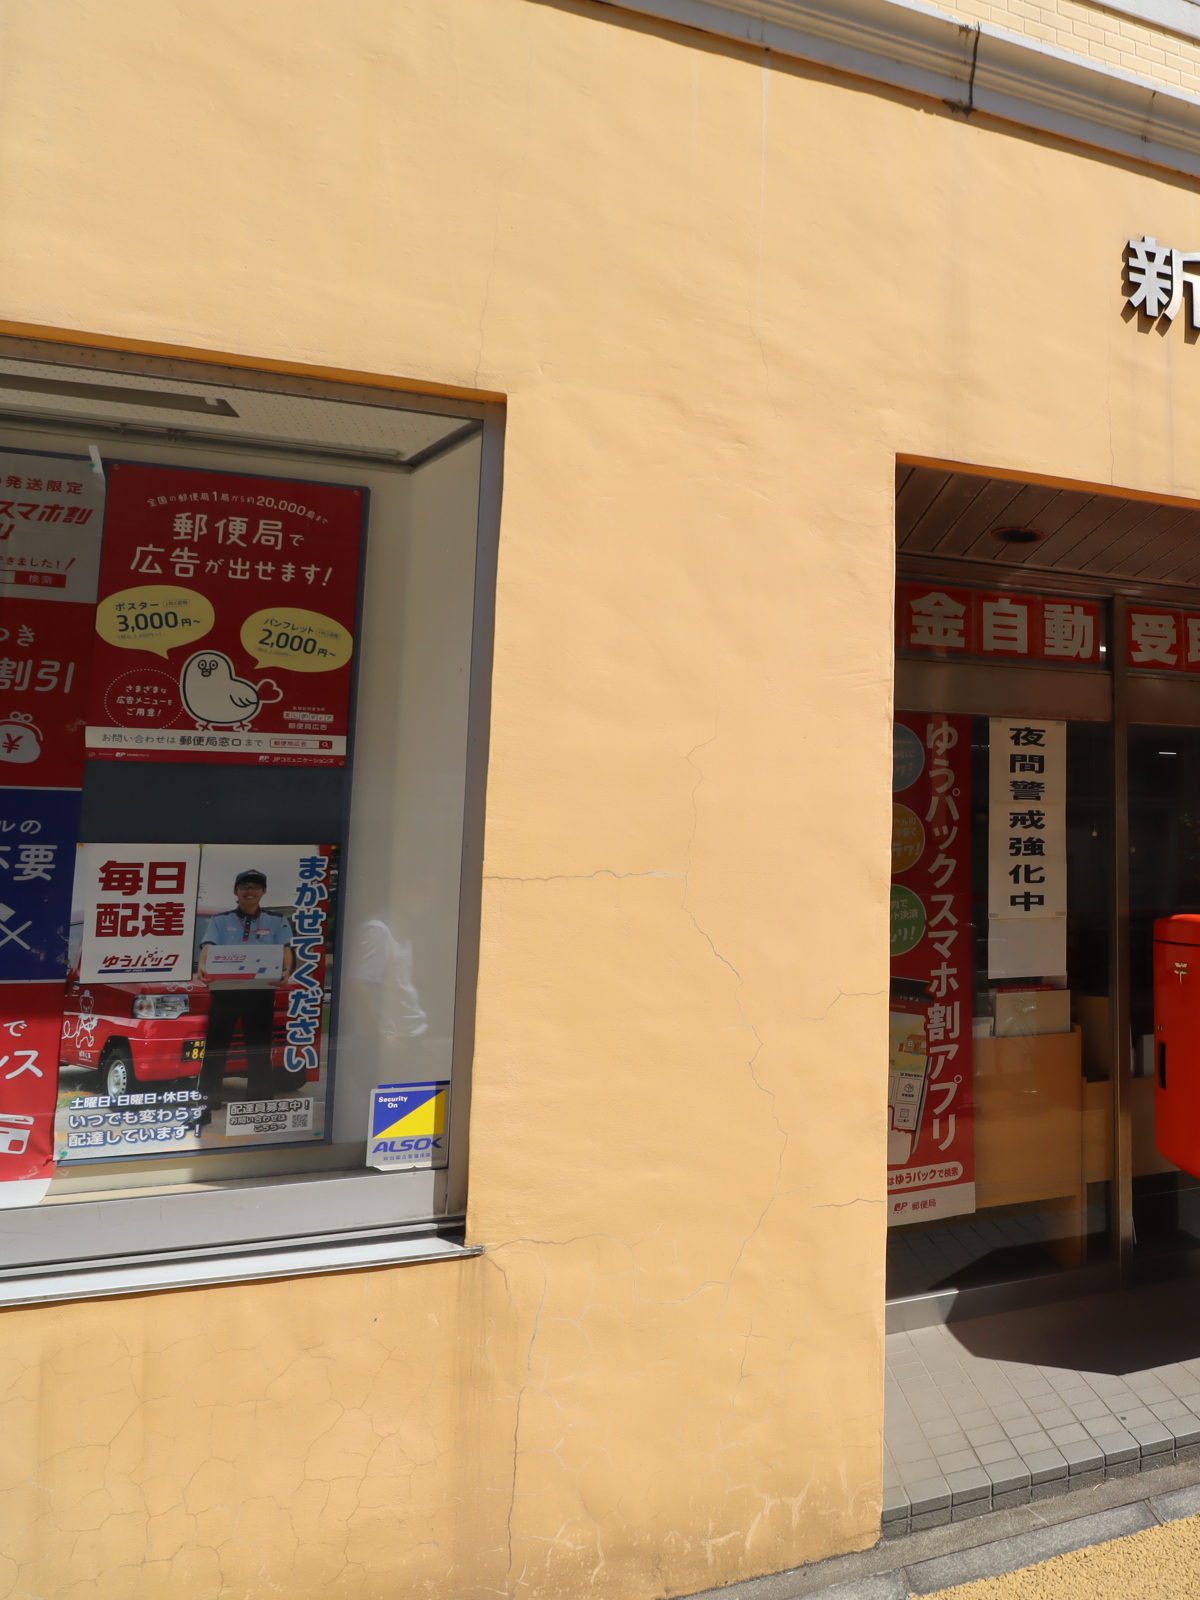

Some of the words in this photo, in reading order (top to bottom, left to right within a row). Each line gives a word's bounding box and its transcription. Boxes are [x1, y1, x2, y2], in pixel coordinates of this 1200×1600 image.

[0, 475, 84, 496] 発送限定
[173, 511, 305, 551] 郵便局で
[0, 556, 61, 570] きました!
[130, 543, 333, 587] 広告が出せます!
[28, 573, 54, 585] 検索
[115, 601, 159, 612] ポスター
[264, 618, 315, 635] パンフレット
[0, 657, 76, 695] 割引
[125, 684, 168, 695] さまざまな
[126, 707, 162, 717] ご用意!
[1008, 726, 1047, 912] 夜間警戒強化中
[98, 860, 187, 897] 毎日
[95, 901, 186, 938] 配達
[925, 720, 963, 1152] ゆうパックスマホ割アプリ
[102, 953, 180, 968] ゆうパック
[284, 855, 329, 1073] まかせてください
[378, 1096, 408, 1104] Security
[69, 1105, 208, 1129] いつでも変わらず
[229, 1114, 288, 1125] お問い合わせは
[68, 1123, 202, 1148] 配達しています!
[371, 1136, 443, 1154] ALSOK
[911, 1199, 937, 1212] 郵便局
